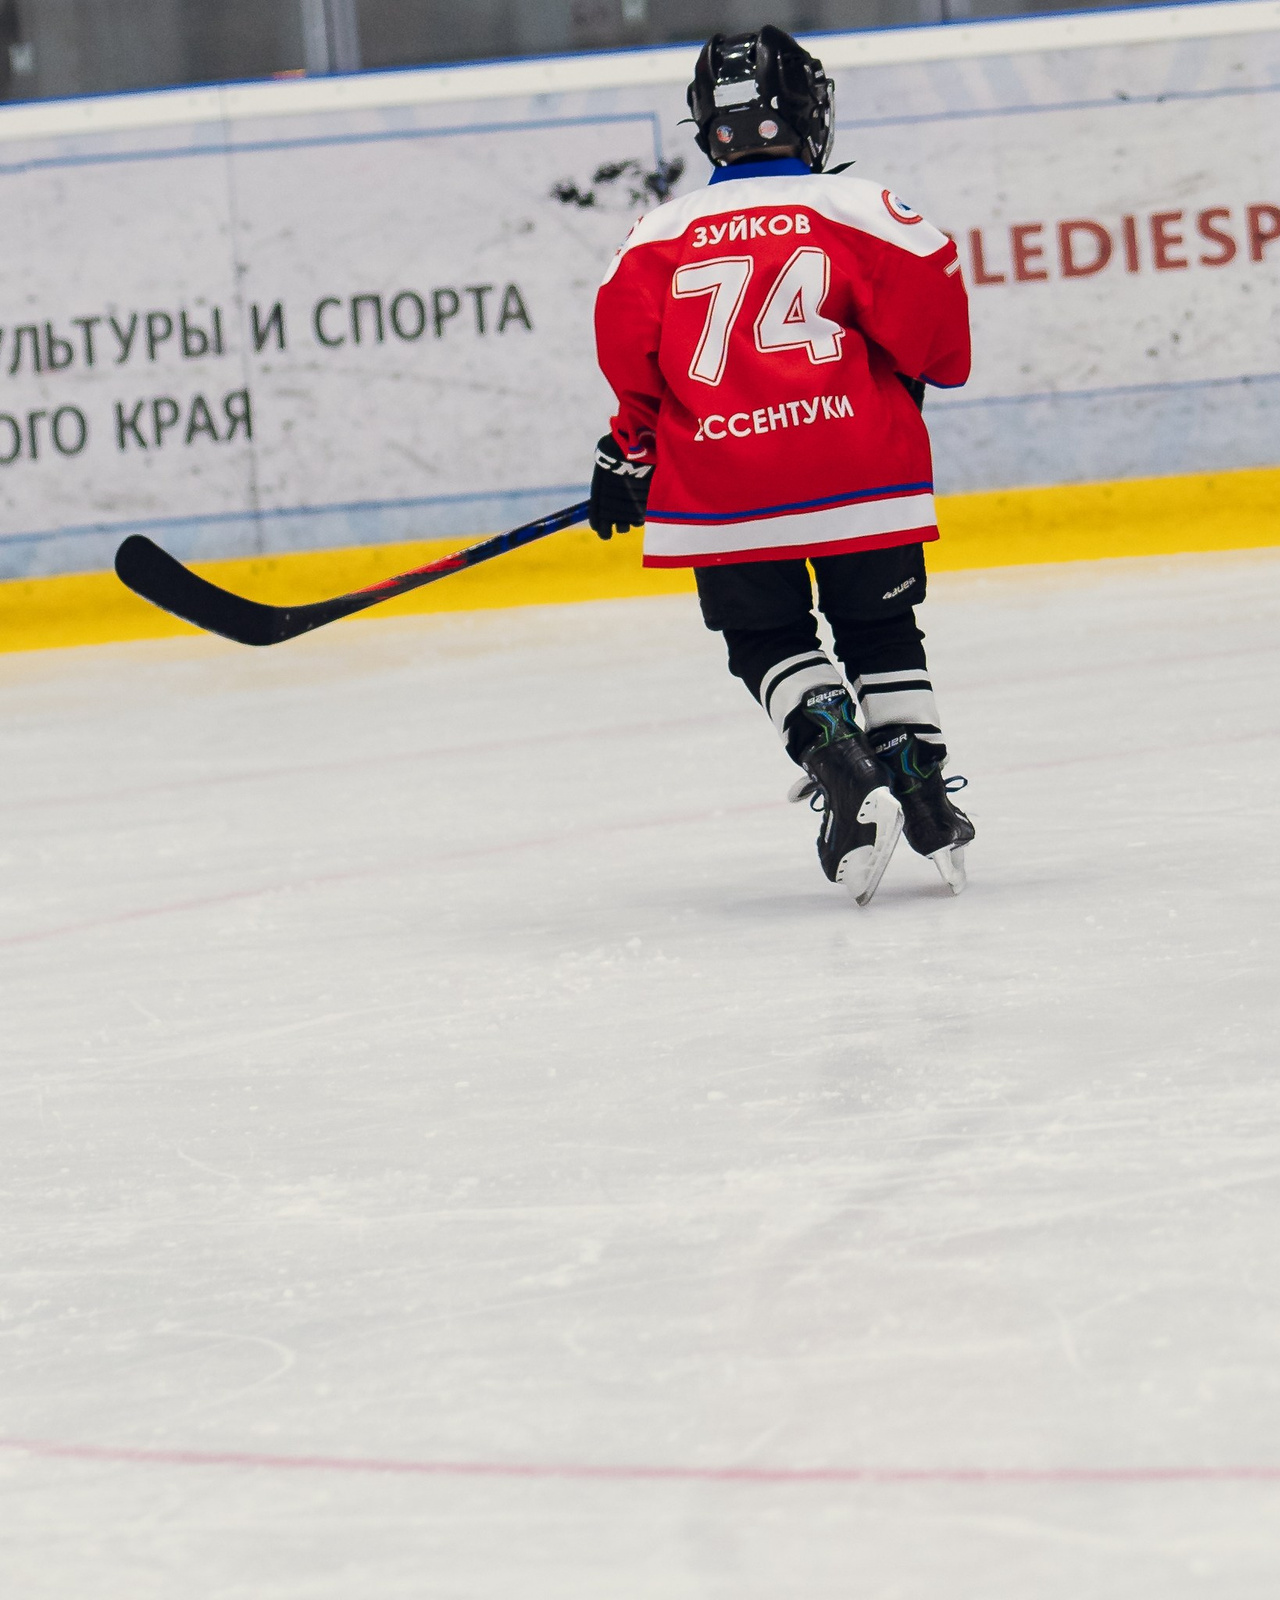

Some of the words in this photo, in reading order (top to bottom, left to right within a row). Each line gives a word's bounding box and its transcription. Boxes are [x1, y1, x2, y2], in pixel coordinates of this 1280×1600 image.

[691, 214, 811, 248] ЗУЙКОВ
[0, 304, 224, 376] ЛЬТУРЫ
[250, 300, 286, 352] И
[312, 282, 533, 348] СПОРТА
[672, 246, 846, 387] 74
[115, 387, 252, 450] КРАЯ
[594, 448, 653, 479] CM
[807, 689, 846, 707] BAUER
